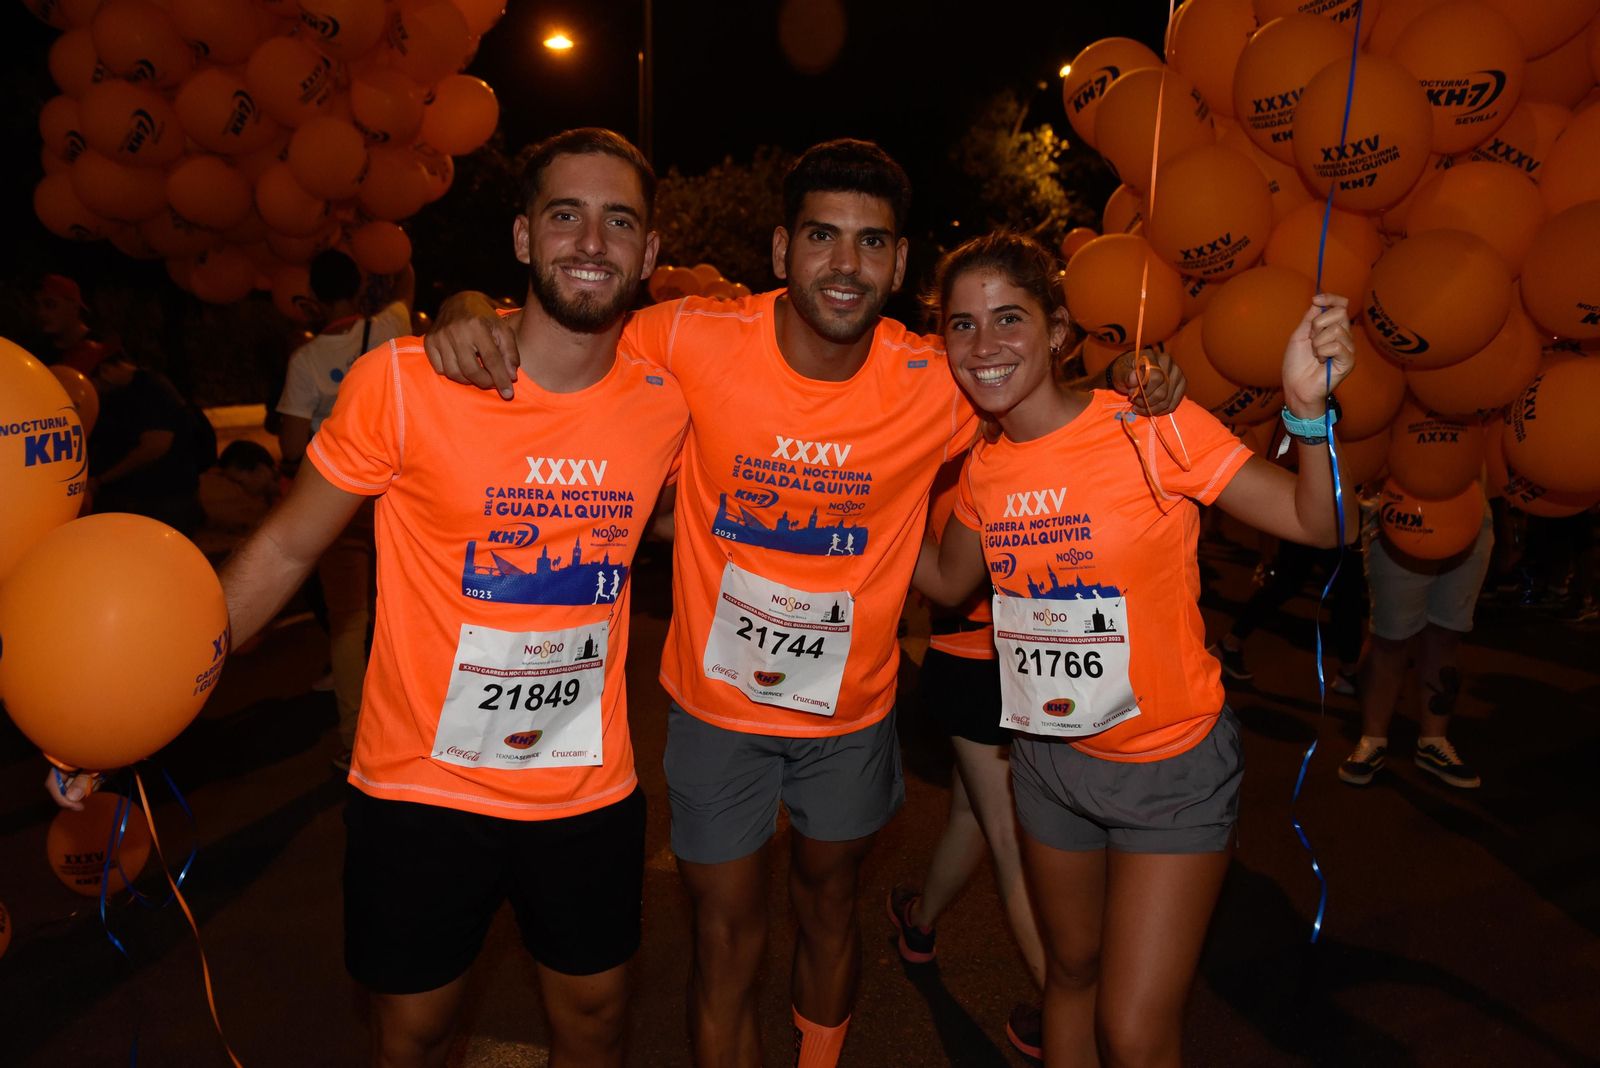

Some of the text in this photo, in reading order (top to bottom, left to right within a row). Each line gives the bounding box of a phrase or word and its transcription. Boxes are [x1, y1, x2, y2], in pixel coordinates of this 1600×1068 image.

[1420, 79, 1470, 88] OCTURNA
[1278, 108, 1296, 117] NOC
[1455, 111, 1498, 125] SEVILLA
[1272, 130, 1293, 144] KH
[1313, 145, 1398, 170] CARRERA NOCTURNA
[1321, 134, 1379, 162] XXXV
[1487, 138, 1540, 173] XXXV
[1320, 152, 1400, 177] GUADALQUIVIR
[1180, 232, 1232, 260] XXXV
[1372, 290, 1399, 331] NOCTURNA
[1576, 302, 1600, 312] NOC
[0, 416, 68, 437] NOCTURNA
[1416, 432, 1459, 444] XXXV
[771, 435, 851, 467] XXXV
[524, 456, 608, 486] XXXV
[732, 465, 741, 478] DEL
[735, 455, 872, 482] CARRERA NOCTURNA
[742, 469, 870, 496] GUADALQUIVIR
[485, 486, 634, 502] CARRERA NOCTURNA
[1003, 487, 1067, 518] XXXV
[484, 499, 493, 516] DEL
[496, 502, 633, 518] GUADALQUIVIR
[985, 513, 1091, 532] CARRERA NOCTURNA
[715, 528, 737, 540] 2023
[989, 526, 1091, 548] GUADALQUIVIR
[465, 588, 492, 600] 2023
[737, 600, 757, 614] CARRERA
[757, 610, 783, 626] NOCTURNA
[793, 622, 828, 631] GUADALQUIVIR
[736, 616, 825, 659] 21744
[549, 664, 581, 674] GUADALQUIVIR
[1015, 647, 1104, 678] 21766
[478, 678, 580, 711] 21849
[792, 694, 829, 707] Cruzcampo
[552, 750, 592, 758] Cruzcamp
[64, 851, 104, 864] XXXV
